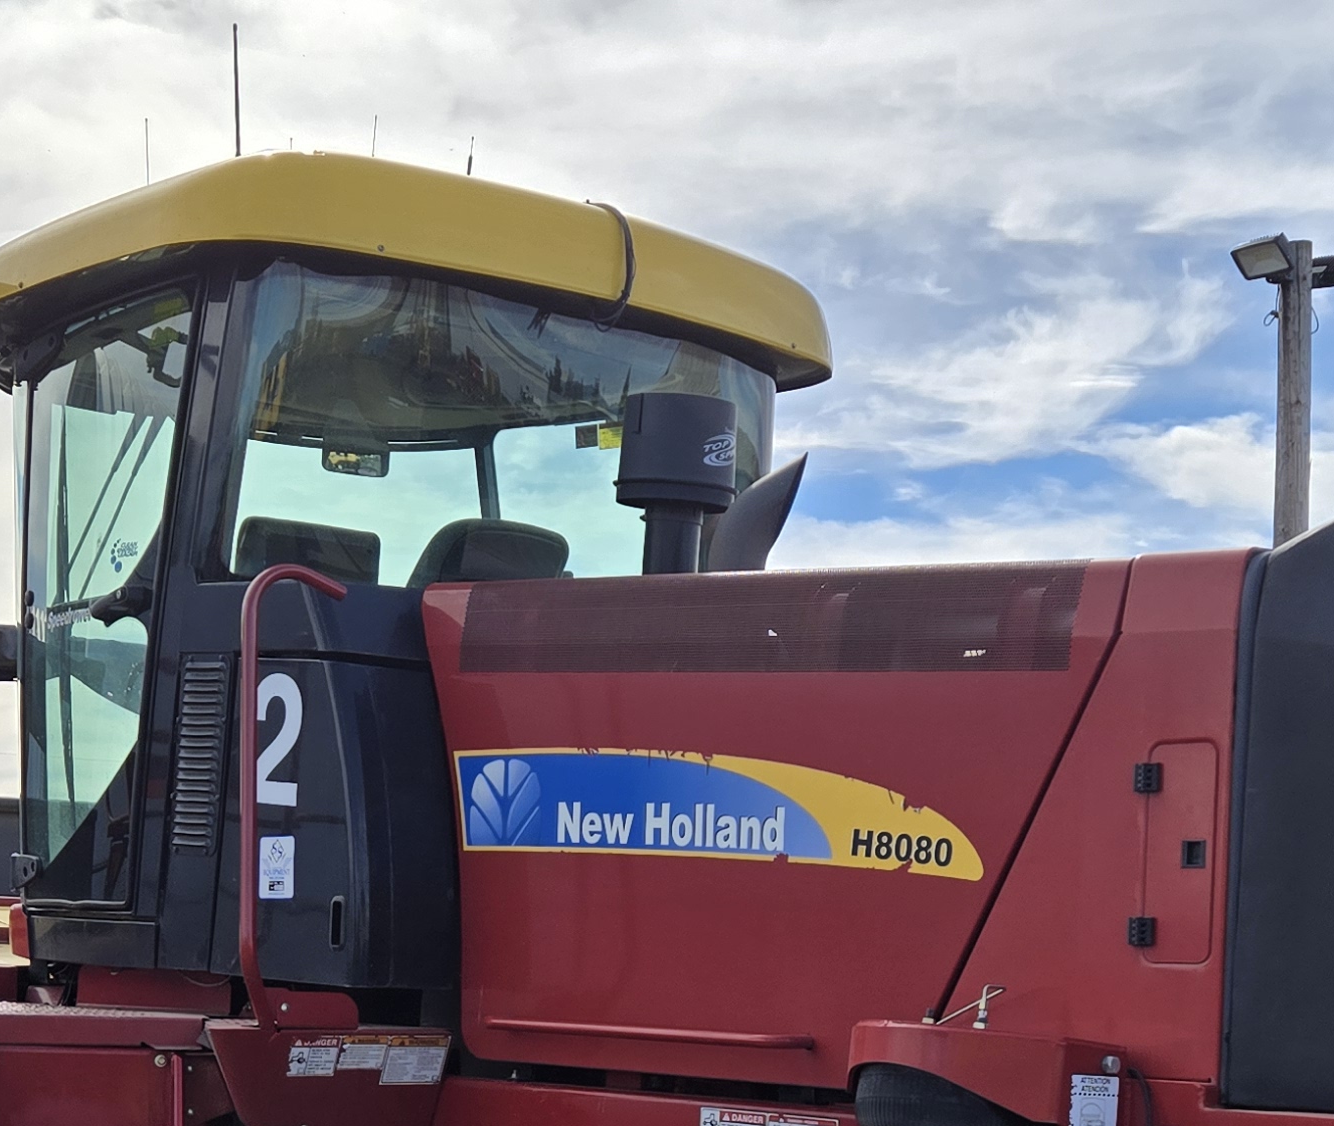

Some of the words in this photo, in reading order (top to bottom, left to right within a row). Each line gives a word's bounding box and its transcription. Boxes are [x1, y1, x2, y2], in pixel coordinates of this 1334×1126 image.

[703, 440, 729, 452] TOP
[256, 671, 304, 807] 2
[556, 801, 634, 844] New
[644, 802, 786, 852] Holland
[851, 828, 954, 868] H8080
[1080, 1077, 1111, 1085] ATTENTION
[731, 1113, 764, 1124] DANGER
